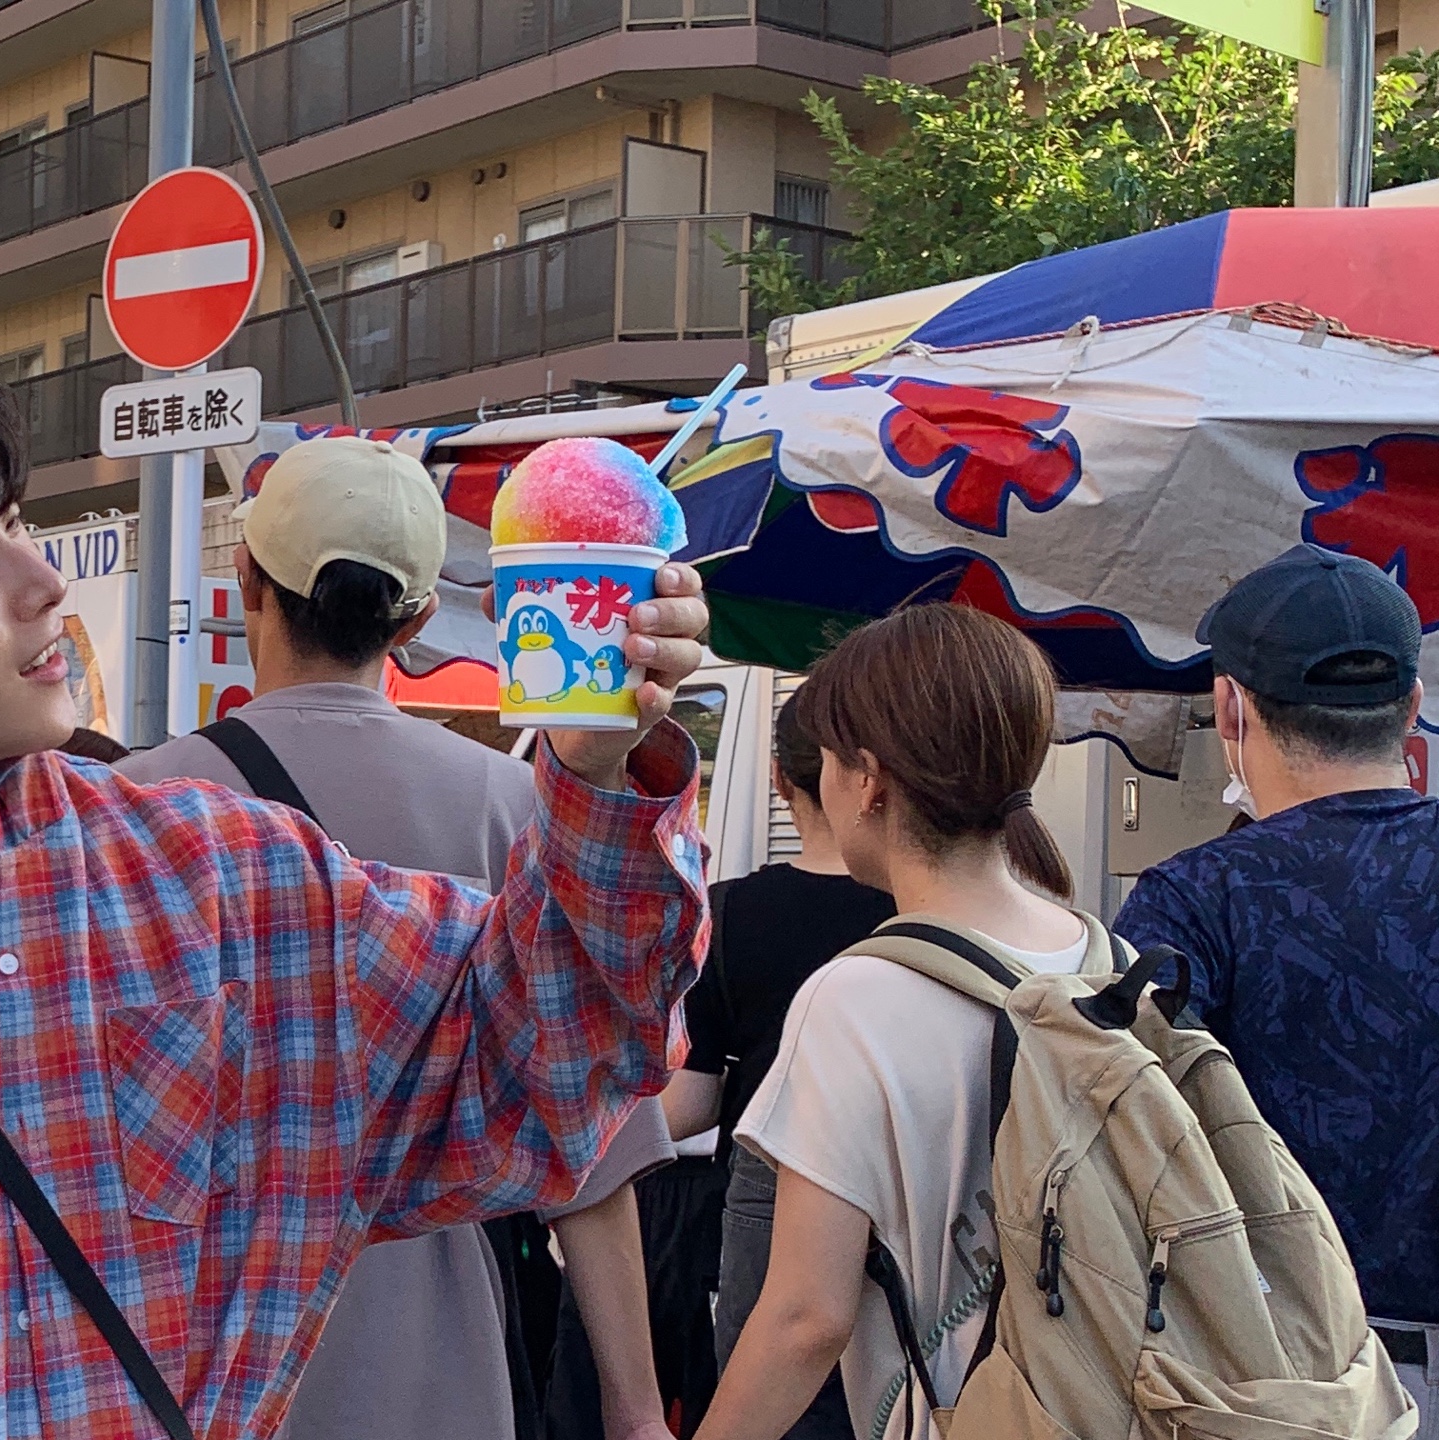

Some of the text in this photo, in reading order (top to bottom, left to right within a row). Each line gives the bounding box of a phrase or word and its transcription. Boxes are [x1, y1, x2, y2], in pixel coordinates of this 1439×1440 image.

[114, 388, 244, 441] 自転車を除く
[515, 577, 564, 596] カップ
[566, 576, 634, 635] 氷
